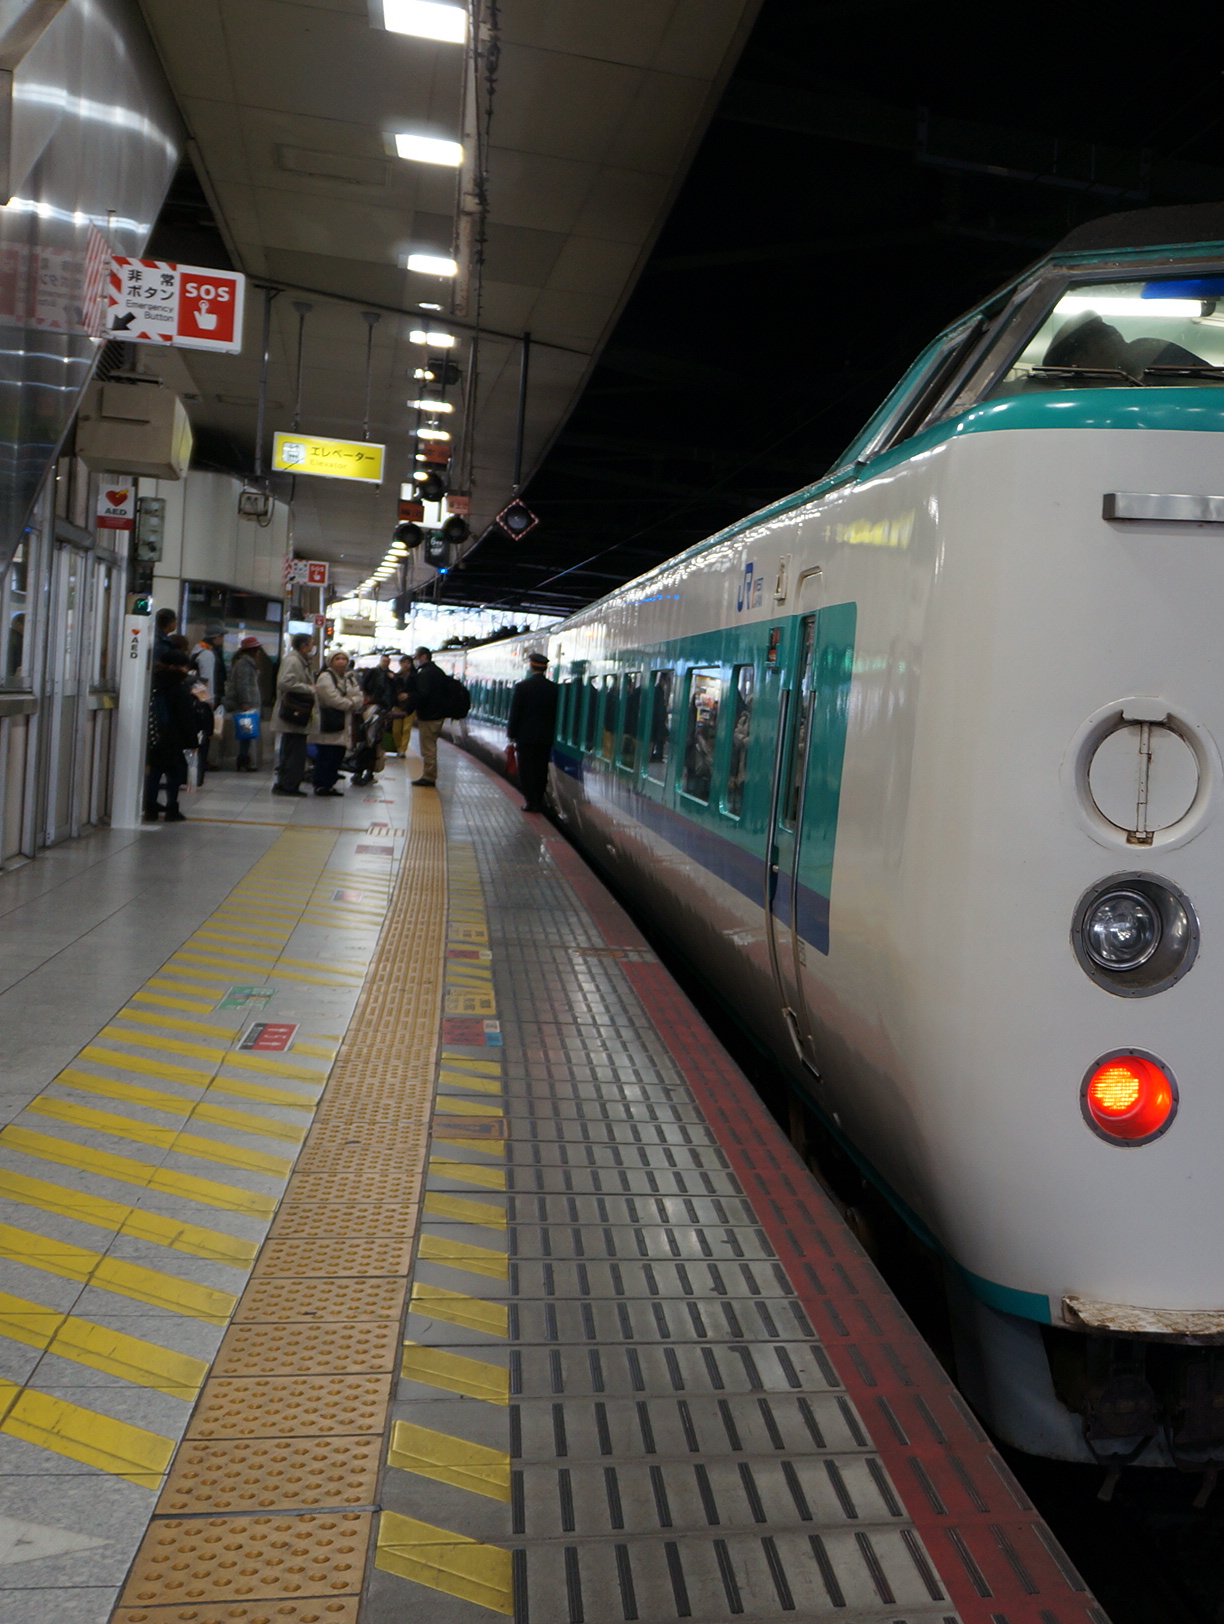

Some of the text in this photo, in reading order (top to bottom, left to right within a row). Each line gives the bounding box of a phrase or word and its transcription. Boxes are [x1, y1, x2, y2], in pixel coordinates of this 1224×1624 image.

[127, 285, 175, 300] ボタン
[185, 282, 230, 302] SOS
[125, 299, 174, 313] Emergency
[144, 311, 174, 322] Button
[310, 446, 376, 462] エレベーター
[309, 459, 347, 470] Elevator
[104, 507, 128, 516] AED
[130, 636, 139, 659] AED
